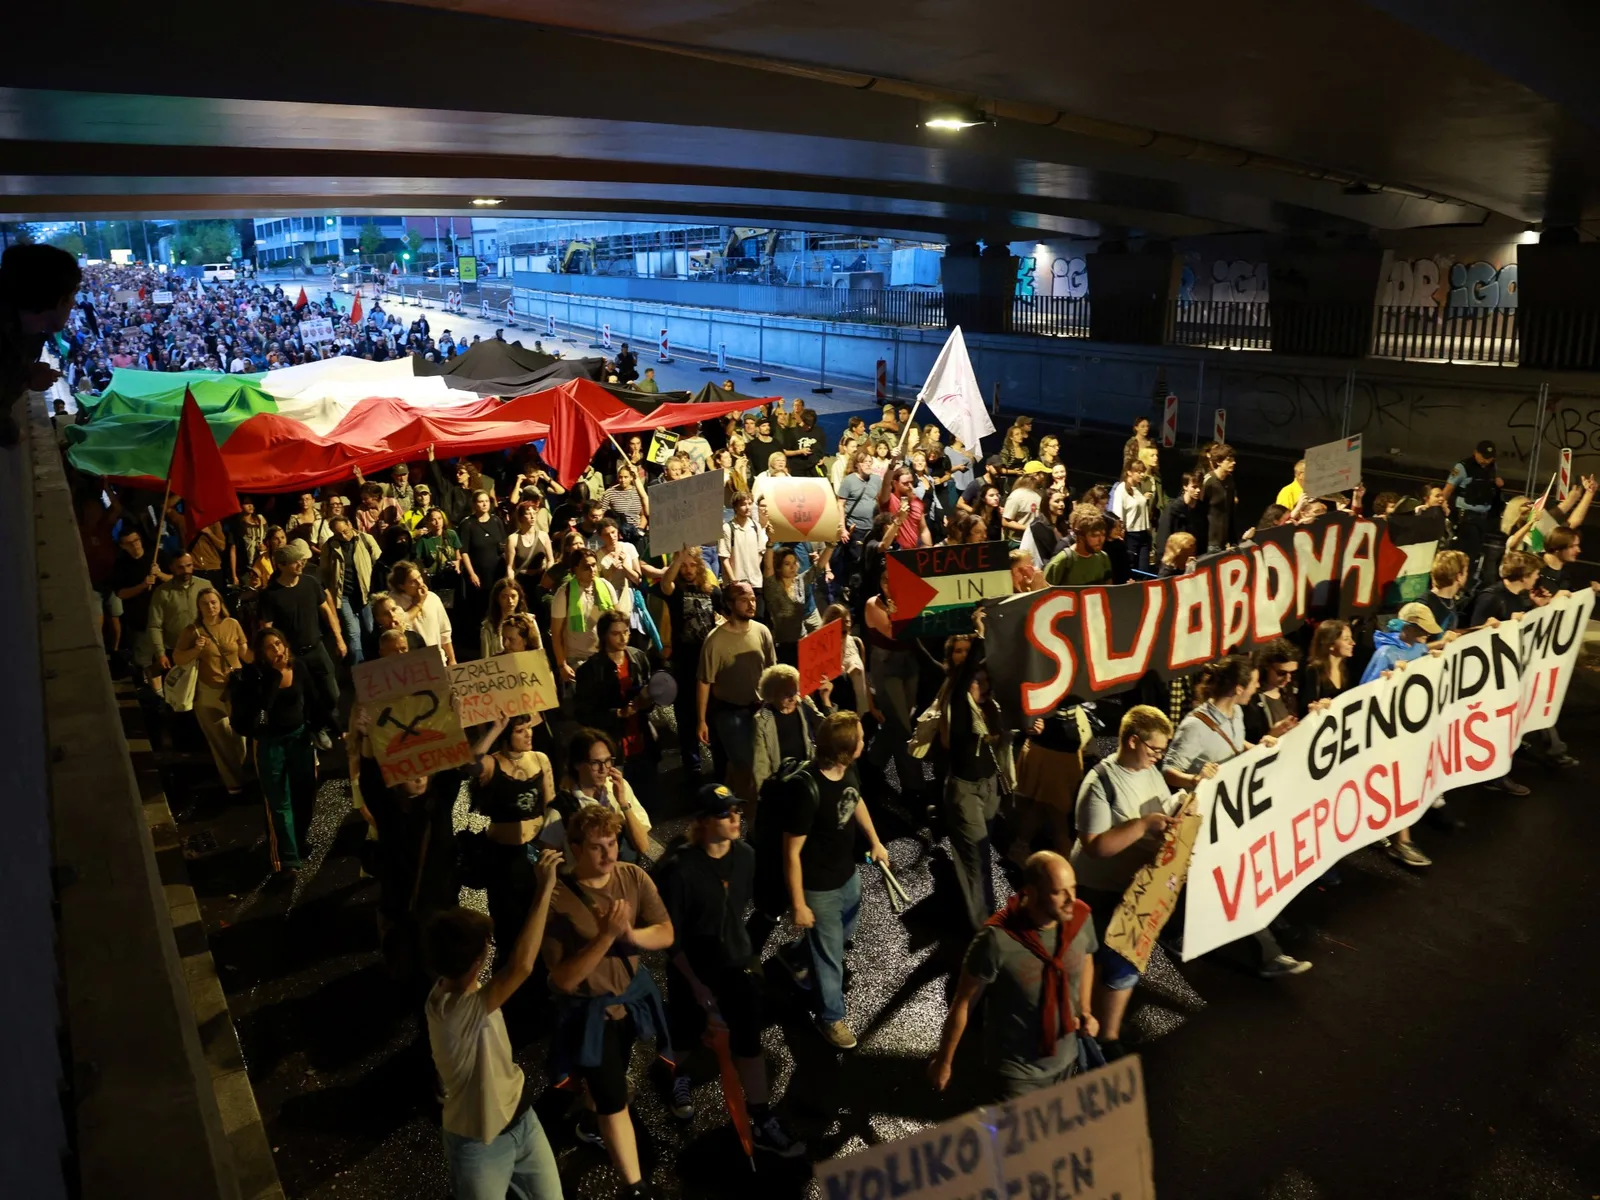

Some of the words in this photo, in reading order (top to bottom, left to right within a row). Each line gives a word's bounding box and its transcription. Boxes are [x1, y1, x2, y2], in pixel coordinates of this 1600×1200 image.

[916, 544, 990, 575] PEACE
[956, 577, 984, 600] IN
[462, 692, 493, 708] ATO
[1210, 751, 1280, 845] NE
[1307, 603, 1584, 780] GENOCIDNEMU
